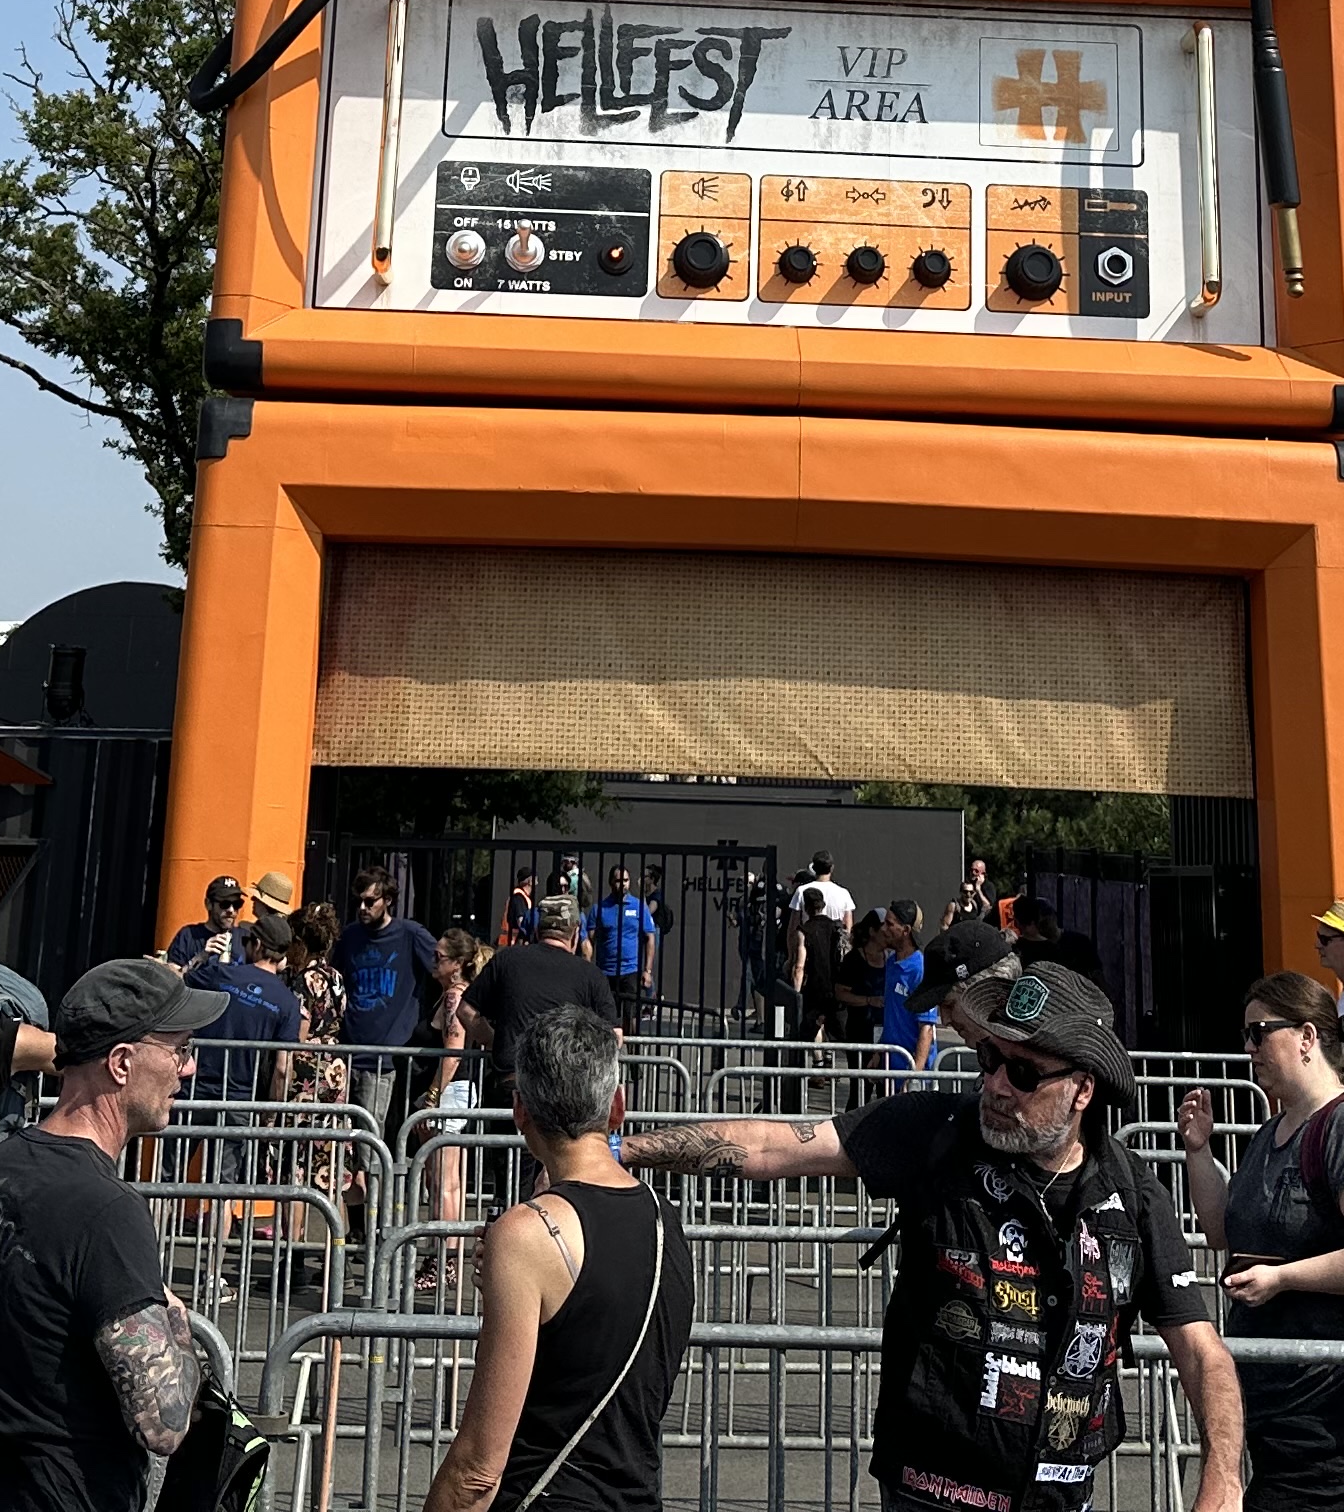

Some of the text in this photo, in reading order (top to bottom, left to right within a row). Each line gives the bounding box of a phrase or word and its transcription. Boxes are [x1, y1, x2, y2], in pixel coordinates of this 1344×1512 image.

[836, 44, 909, 80] VIP
[476, 3, 794, 144] HELLFEST
[808, 88, 930, 125] AREA
[453, 217, 479, 228] OFF
[496, 218, 511, 230] 15
[548, 249, 583, 262] STBY
[453, 277, 473, 288] ON
[497, 279, 551, 292] 7 WATTS
[1091, 291, 1132, 303] INPUT
[902, 1465, 1013, 1512] IRON MAIDEN
